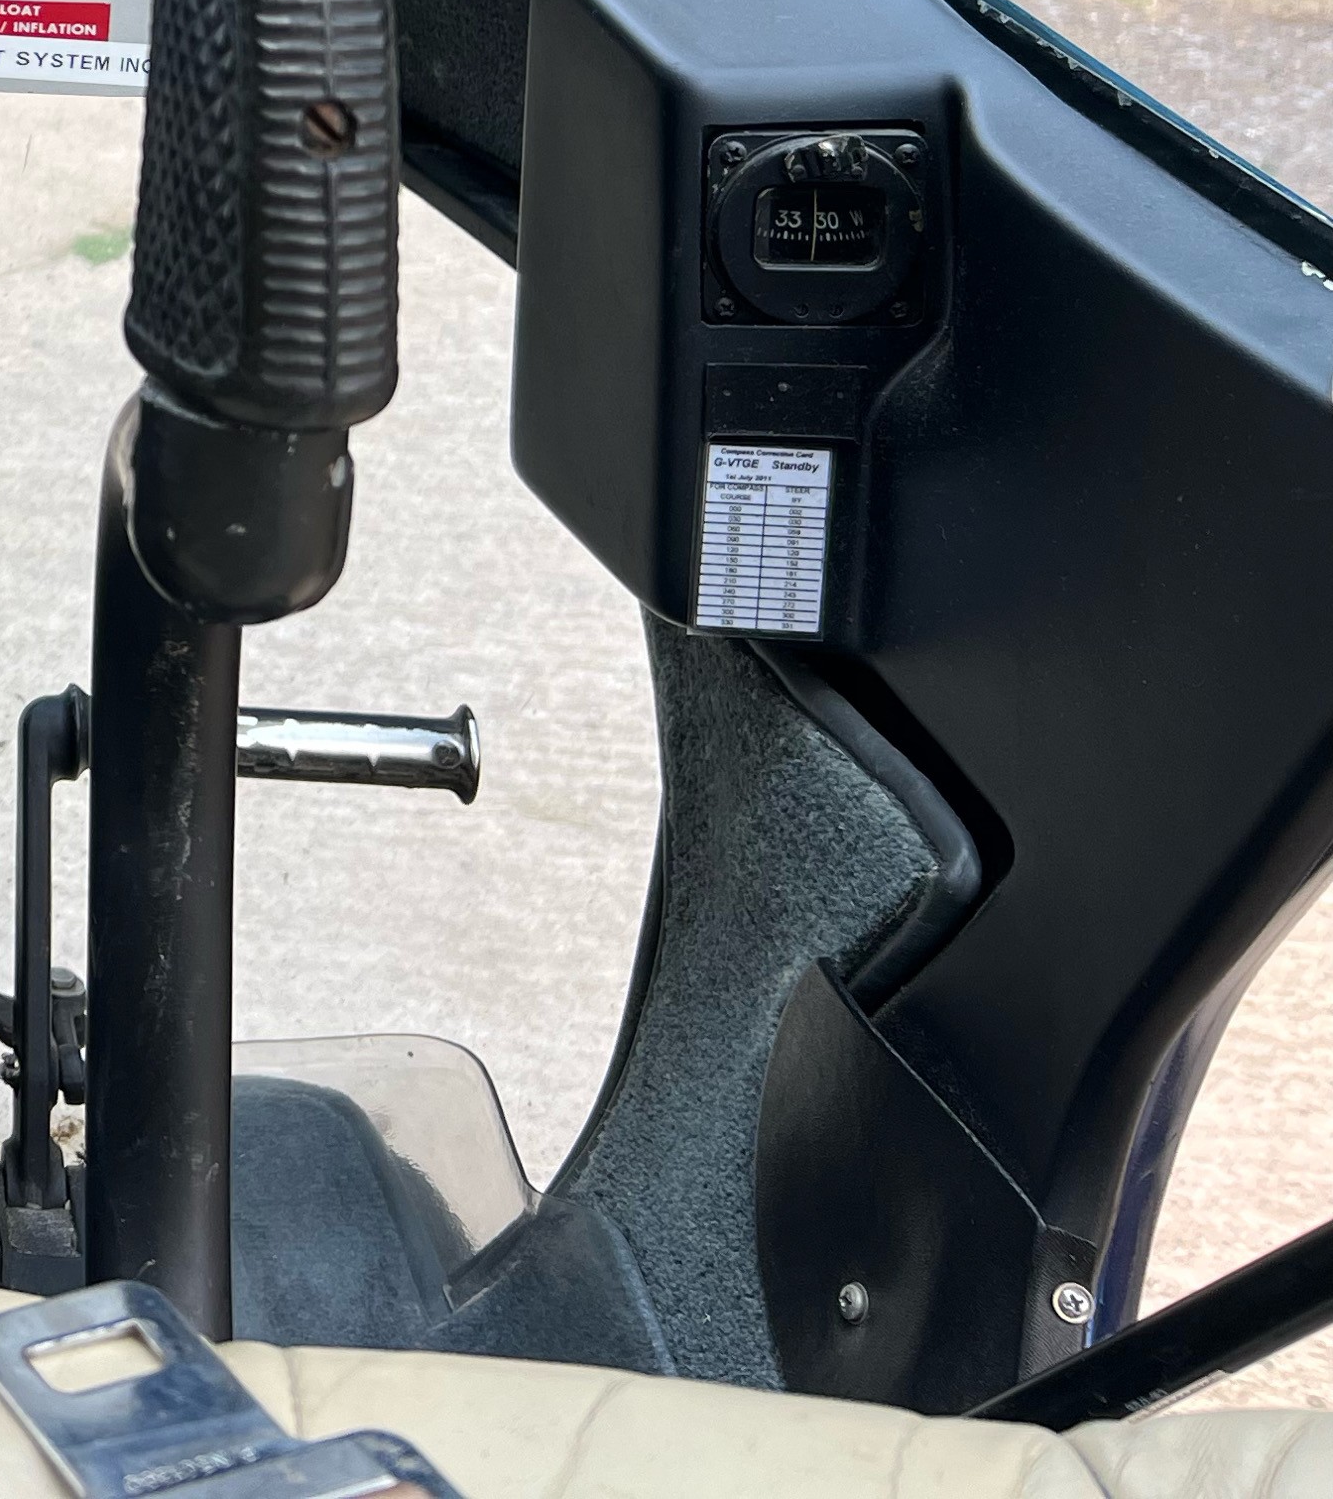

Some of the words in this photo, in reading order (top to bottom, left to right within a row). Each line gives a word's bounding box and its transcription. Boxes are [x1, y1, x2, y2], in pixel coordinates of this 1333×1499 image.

[13, 21, 97, 36] INFLATION
[16, 51, 110, 72] SYSTEM
[714, 457, 760, 468] G-VTGE
[772, 460, 820, 473] Standby
